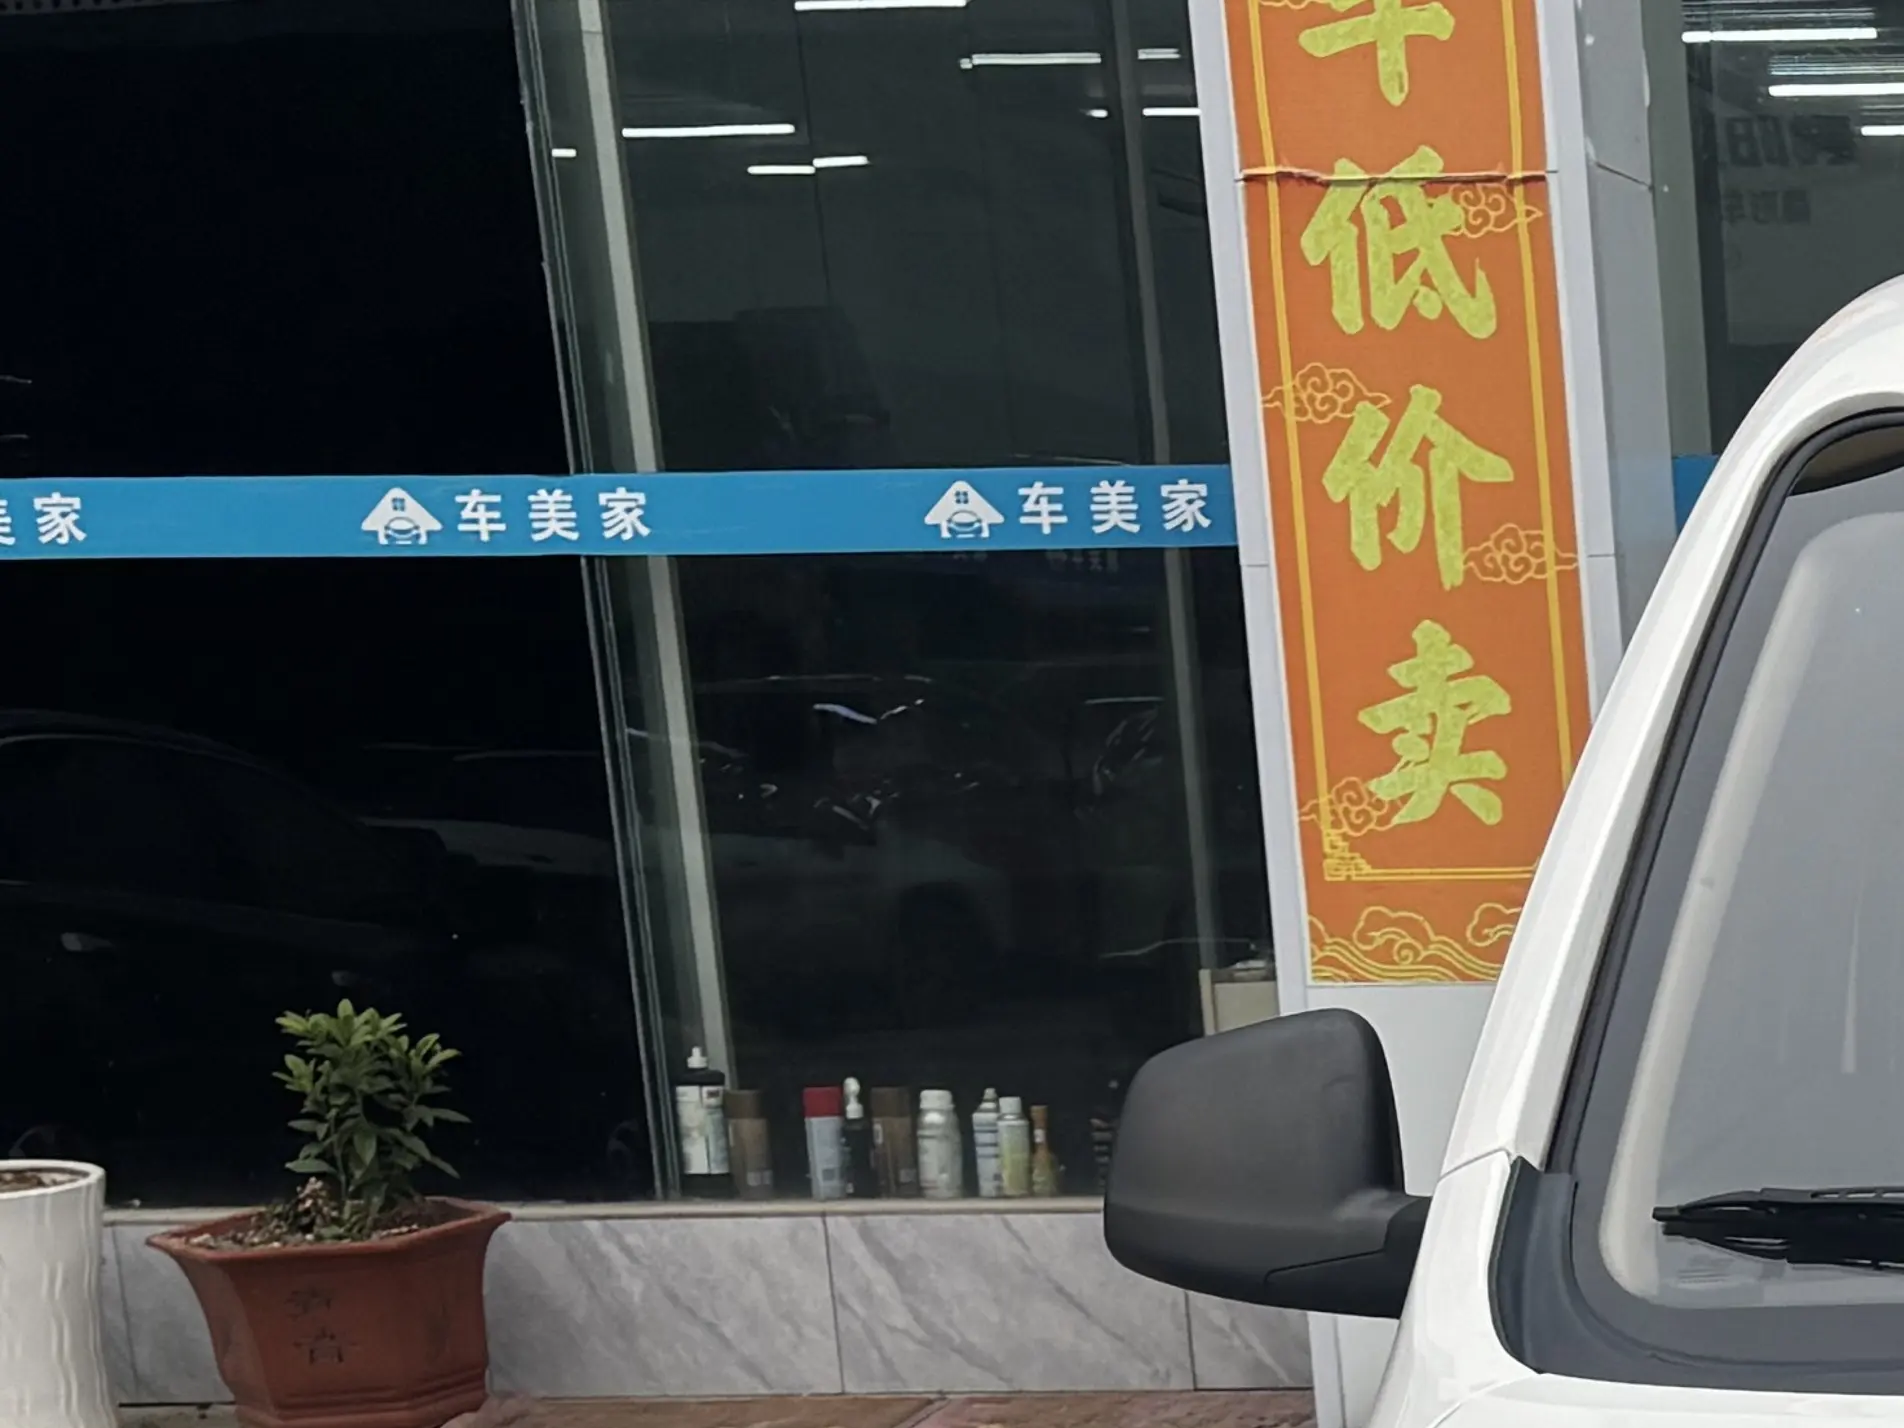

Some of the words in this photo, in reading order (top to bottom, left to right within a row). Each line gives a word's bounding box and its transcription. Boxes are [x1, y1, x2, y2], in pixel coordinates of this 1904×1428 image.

[0, 492, 87, 546] 家
[455, 487, 652, 542] 车美家
[1017, 479, 1212, 535] 车美家
